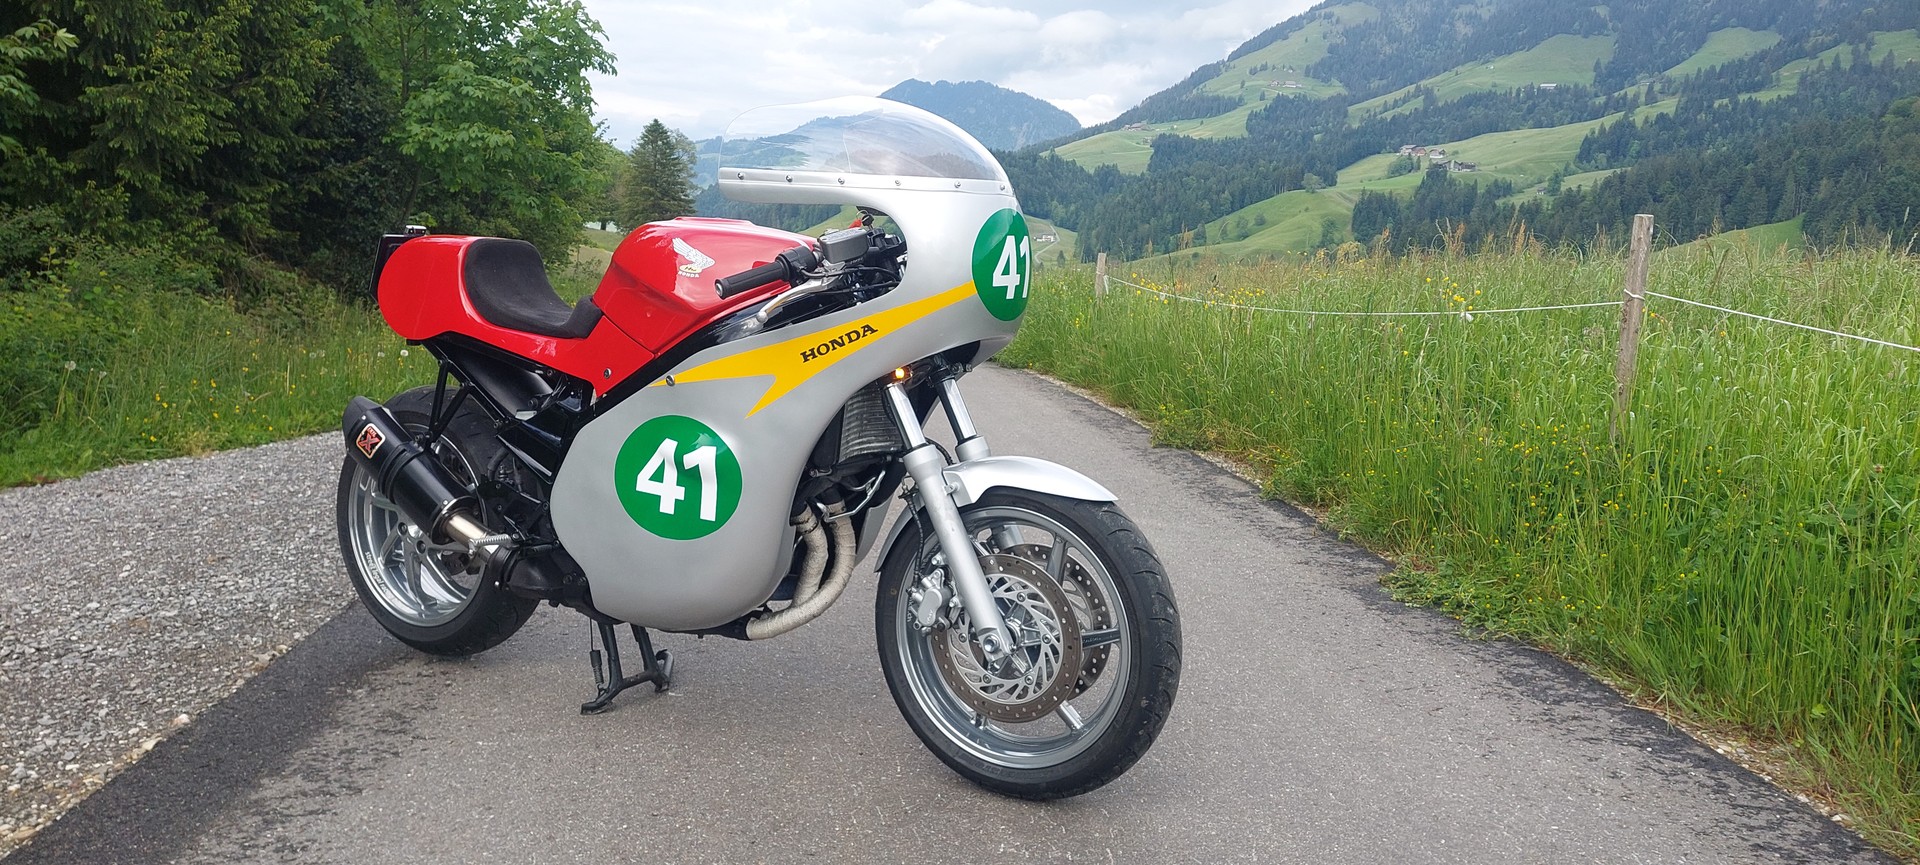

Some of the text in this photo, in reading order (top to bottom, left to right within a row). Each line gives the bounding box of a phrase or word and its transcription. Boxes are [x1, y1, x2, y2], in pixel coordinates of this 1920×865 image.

[678, 270, 700, 278] HONDA
[992, 235, 1030, 299] 41
[800, 324, 878, 363] HONDA
[635, 437, 718, 522] 41
